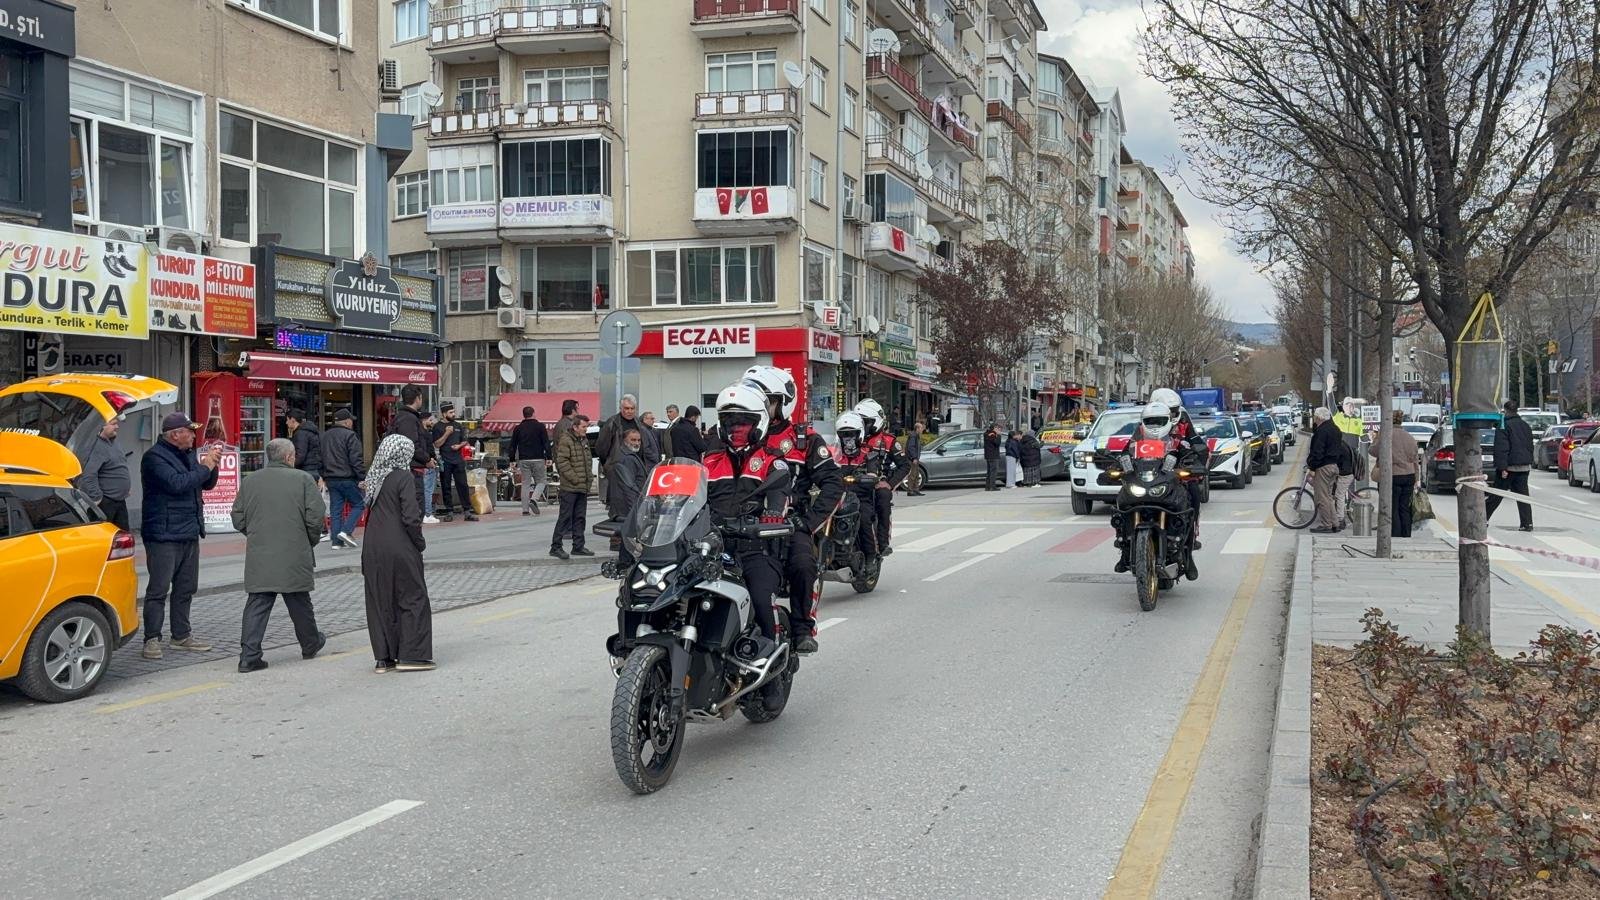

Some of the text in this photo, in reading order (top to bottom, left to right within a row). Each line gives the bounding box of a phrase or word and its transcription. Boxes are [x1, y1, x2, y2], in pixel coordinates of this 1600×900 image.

[17, 15, 45, 39] ŞTİ.
[516, 200, 601, 213] MEMUR-SEN
[156, 254, 196, 276] TURGUT
[205, 262, 244, 282] ÖZ FOTO
[150, 278, 201, 301] KUNDURA
[206, 279, 254, 299] MİLENYUM
[348, 275, 386, 293] Yıldız
[3, 272, 128, 319] DURA
[54, 315, 86, 329] Terlik
[95, 319, 130, 333] Kemer
[667, 327, 751, 345] ECZANE
[813, 331, 840, 352] ECZANE
[692, 345, 727, 355] GÜLVER
[289, 365, 380, 381] YILDIZ KURUYEMİŞ
